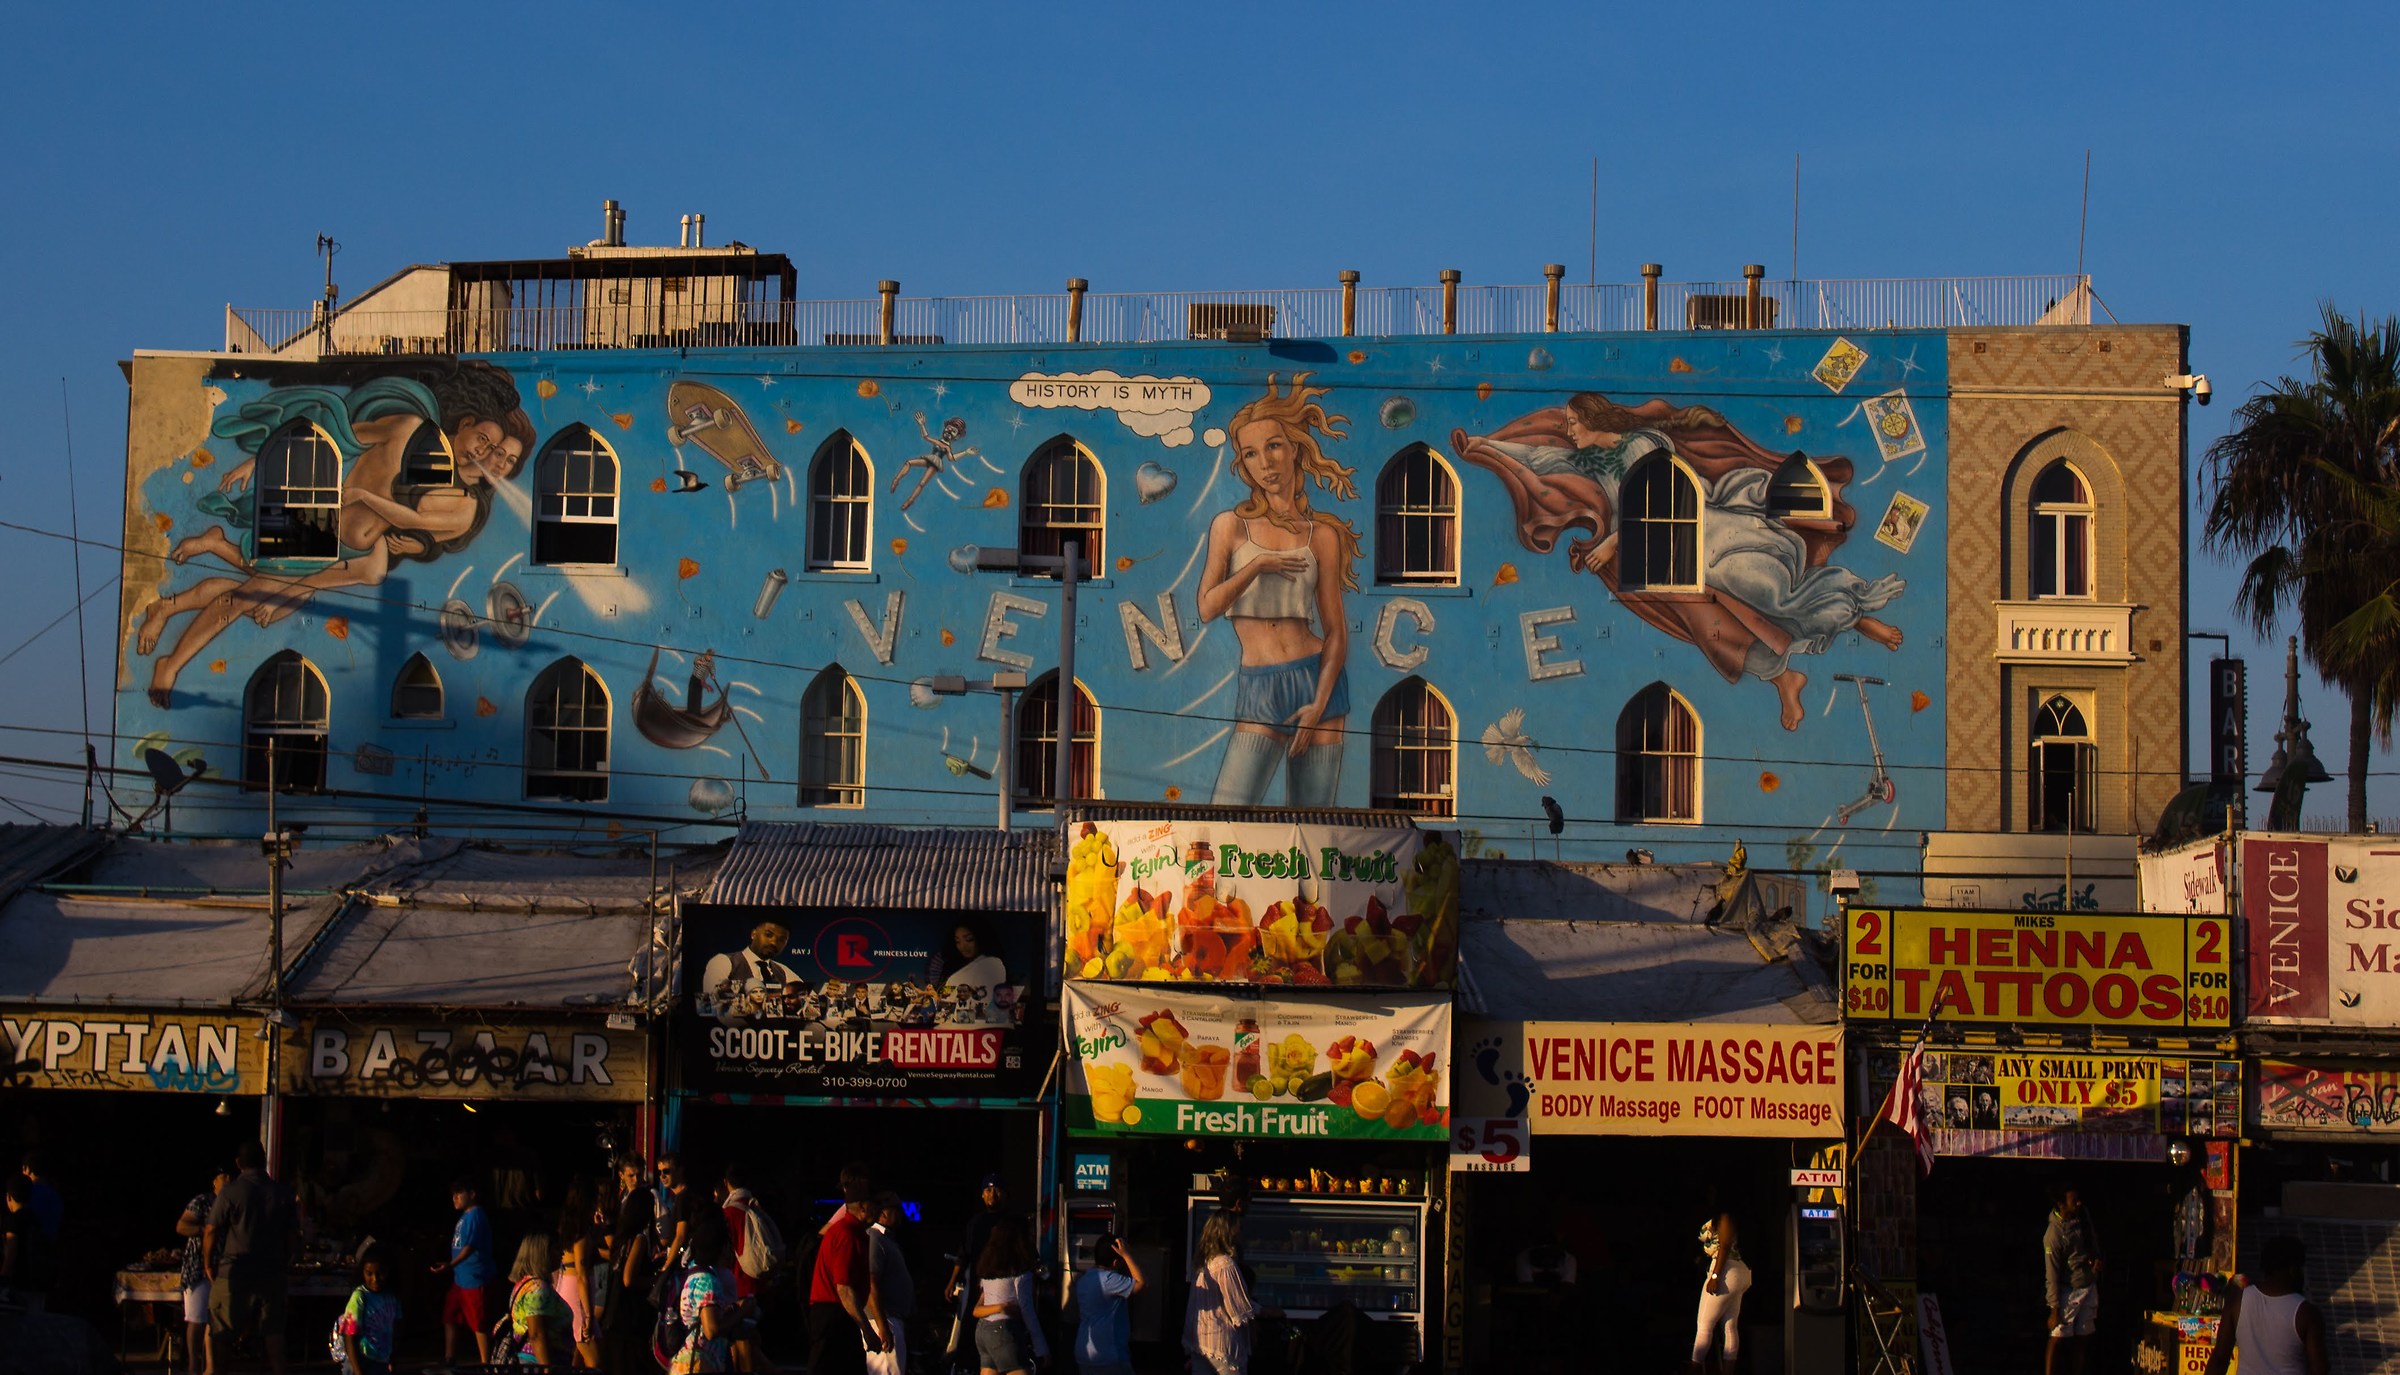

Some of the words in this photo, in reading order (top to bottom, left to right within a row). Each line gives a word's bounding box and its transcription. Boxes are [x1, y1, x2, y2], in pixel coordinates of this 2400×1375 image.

[1026, 383, 1100, 398] HISTORY
[1113, 386, 1129, 399] IS
[1142, 386, 1192, 400] MYTH
[2222, 669, 2239, 774] BAR
[1148, 823, 1172, 838] ZING
[1218, 843, 1311, 880] Fresh
[1320, 846, 1398, 883] Fruit
[2022, 883, 2098, 910] Surfide
[2183, 865, 2217, 900] Sidewalk
[1855, 912, 1882, 955] 2
[2014, 916, 2055, 928] MIKES
[2268, 850, 2301, 1008] VENICE
[873, 949, 908, 957] PRINCESS
[1929, 927, 2153, 970] HENNA
[2195, 920, 2221, 963] 2
[1849, 963, 1887, 980] FOR
[2189, 971, 2227, 989] FOR
[1847, 985, 1889, 1013] $10
[1895, 968, 2184, 1020] TATTOOS
[2188, 994, 2229, 1020] $10
[1093, 1002, 1121, 1017] ZING
[0, 1019, 239, 1075] YPTIAN
[311, 1027, 613, 1085] BAZAAR
[709, 1027, 882, 1063] SCOOT-E-BIKE
[889, 1030, 997, 1064] RENTALS
[1528, 1037, 1655, 1082] VENICE
[1667, 1039, 1836, 1085] MASSAGE
[1998, 1059, 2034, 1077] ANY
[2040, 1060, 2097, 1079] SMALL
[2102, 1061, 2158, 1080] PRINT
[821, 1077, 908, 1088] 310-399-0700
[2017, 1080, 2096, 1104] ONLY
[2105, 1079, 2138, 1106] $5
[1176, 1103, 1254, 1133] Fresh
[1261, 1106, 1329, 1135] Fruit
[1541, 1094, 1594, 1117] BODY
[1600, 1095, 1681, 1123] Massage
[1694, 1096, 1745, 1119] FOOT
[1751, 1097, 1832, 1126] Massage
[1458, 1120, 1520, 1164] $5
[1075, 1164, 1109, 1176] ATM
[1466, 1162, 1516, 1171] MASSAGE
[1796, 1173, 1836, 1182] ATM
